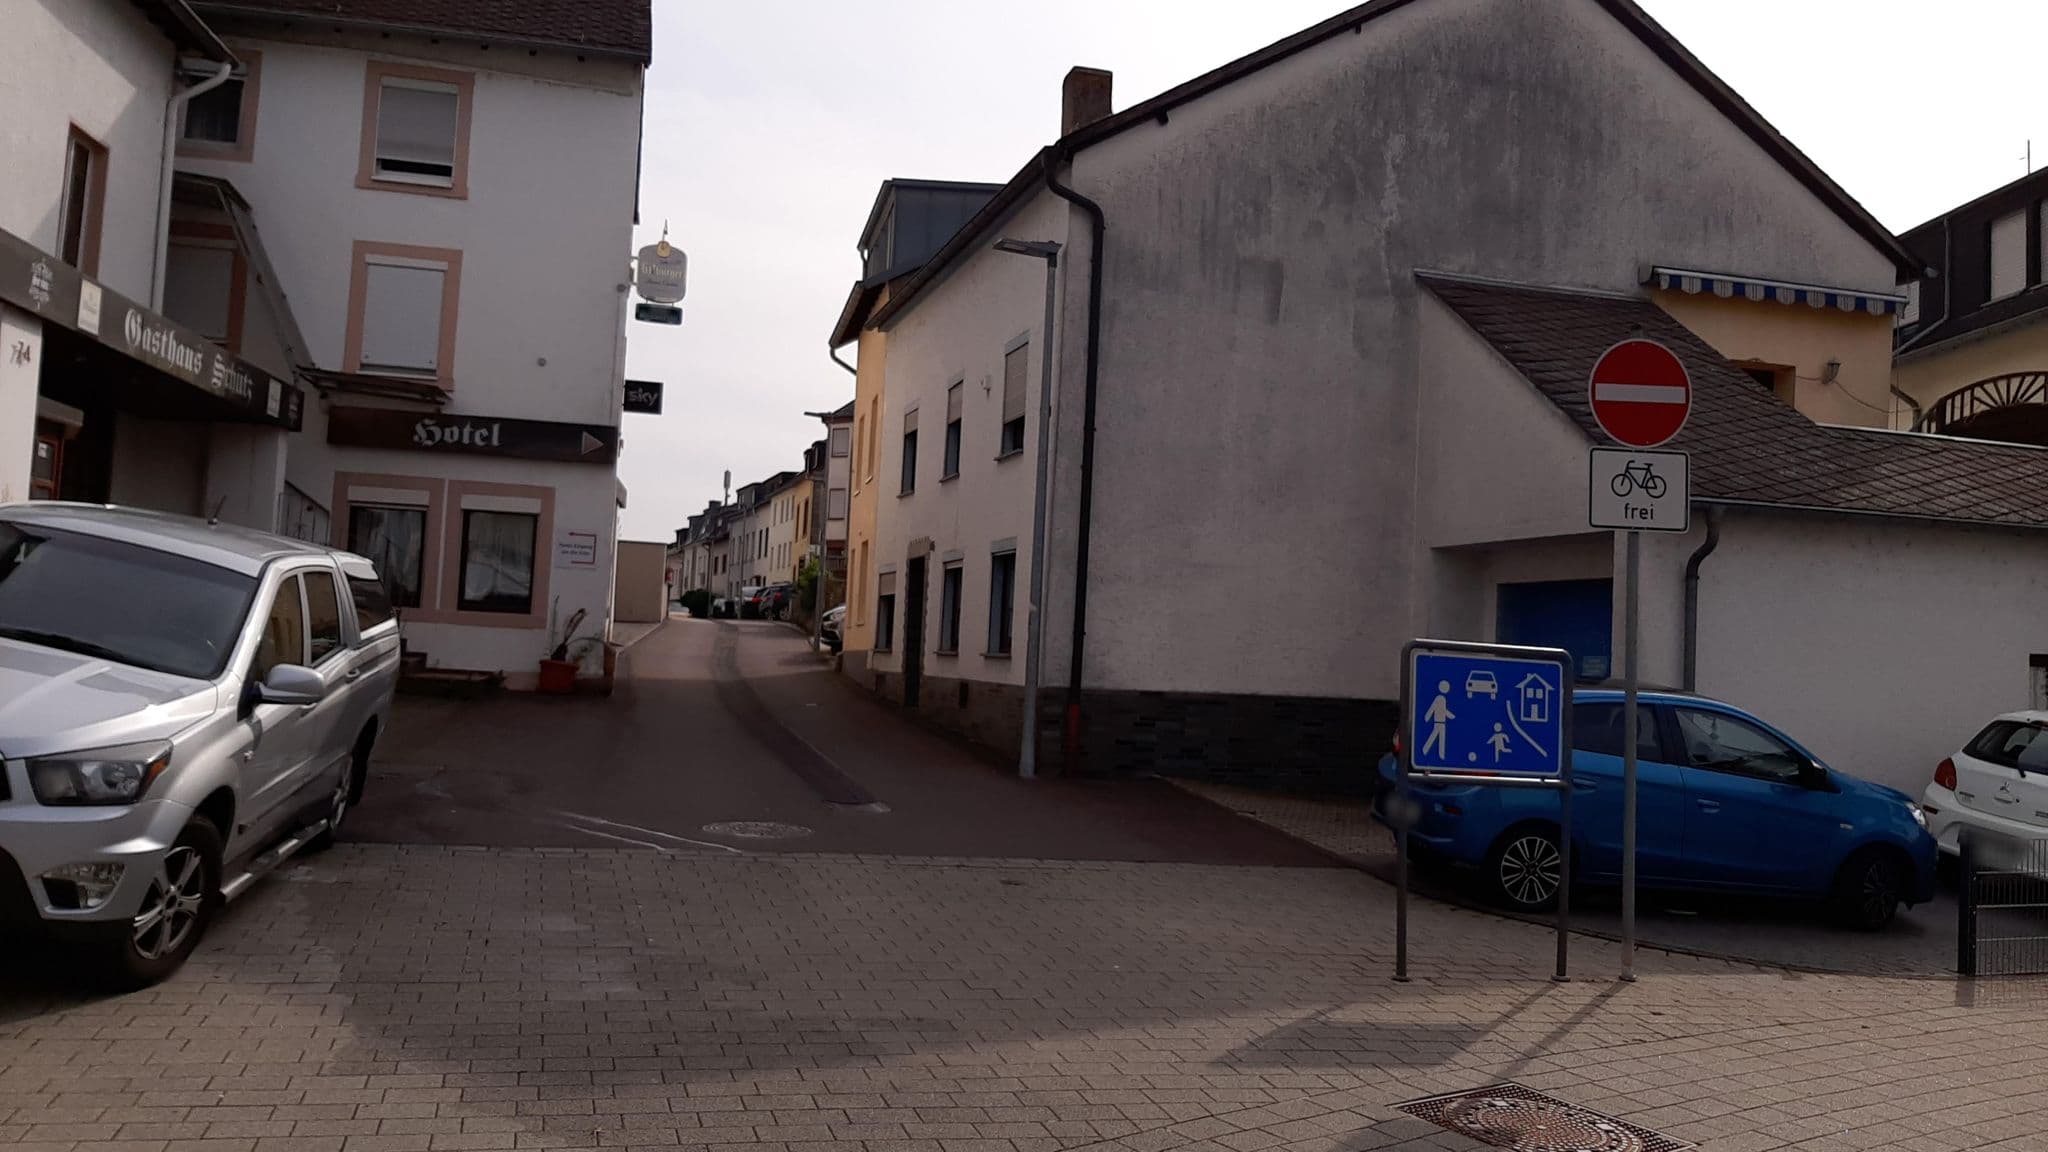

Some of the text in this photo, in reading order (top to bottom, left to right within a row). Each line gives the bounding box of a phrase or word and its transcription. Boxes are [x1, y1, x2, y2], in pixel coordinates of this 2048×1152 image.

[124, 307, 204, 375] Gasthaus
[628, 387, 658, 407] sky
[413, 418, 502, 447] Hotel
[1624, 502, 1655, 520] frei
